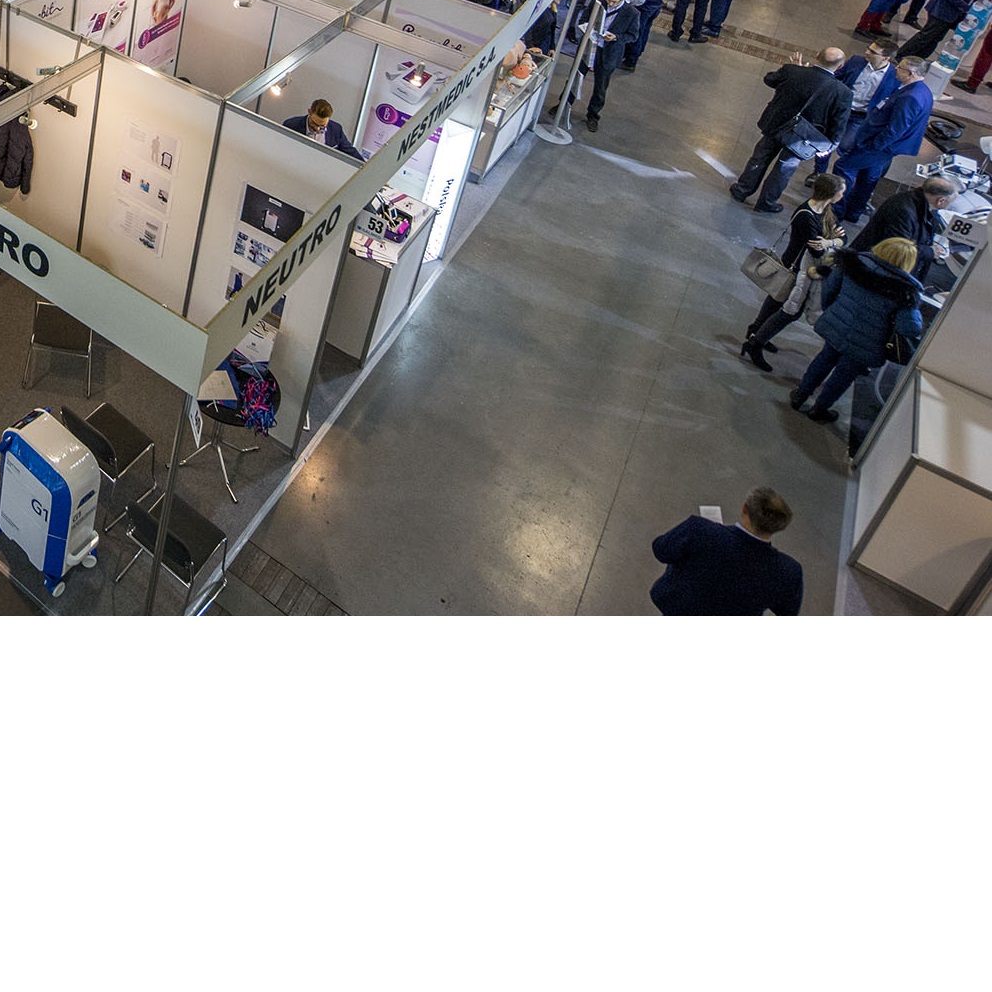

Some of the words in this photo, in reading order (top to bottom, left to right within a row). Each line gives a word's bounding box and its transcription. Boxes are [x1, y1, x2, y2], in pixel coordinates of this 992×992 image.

[397, 67, 476, 162] NESTMEDIC
[476, 45, 496, 79] S.A.
[367, 217, 384, 234] 53
[951, 219, 973, 236] 88
[241, 203, 342, 328] NEUTRO
[31, 498, 49, 523] G1
